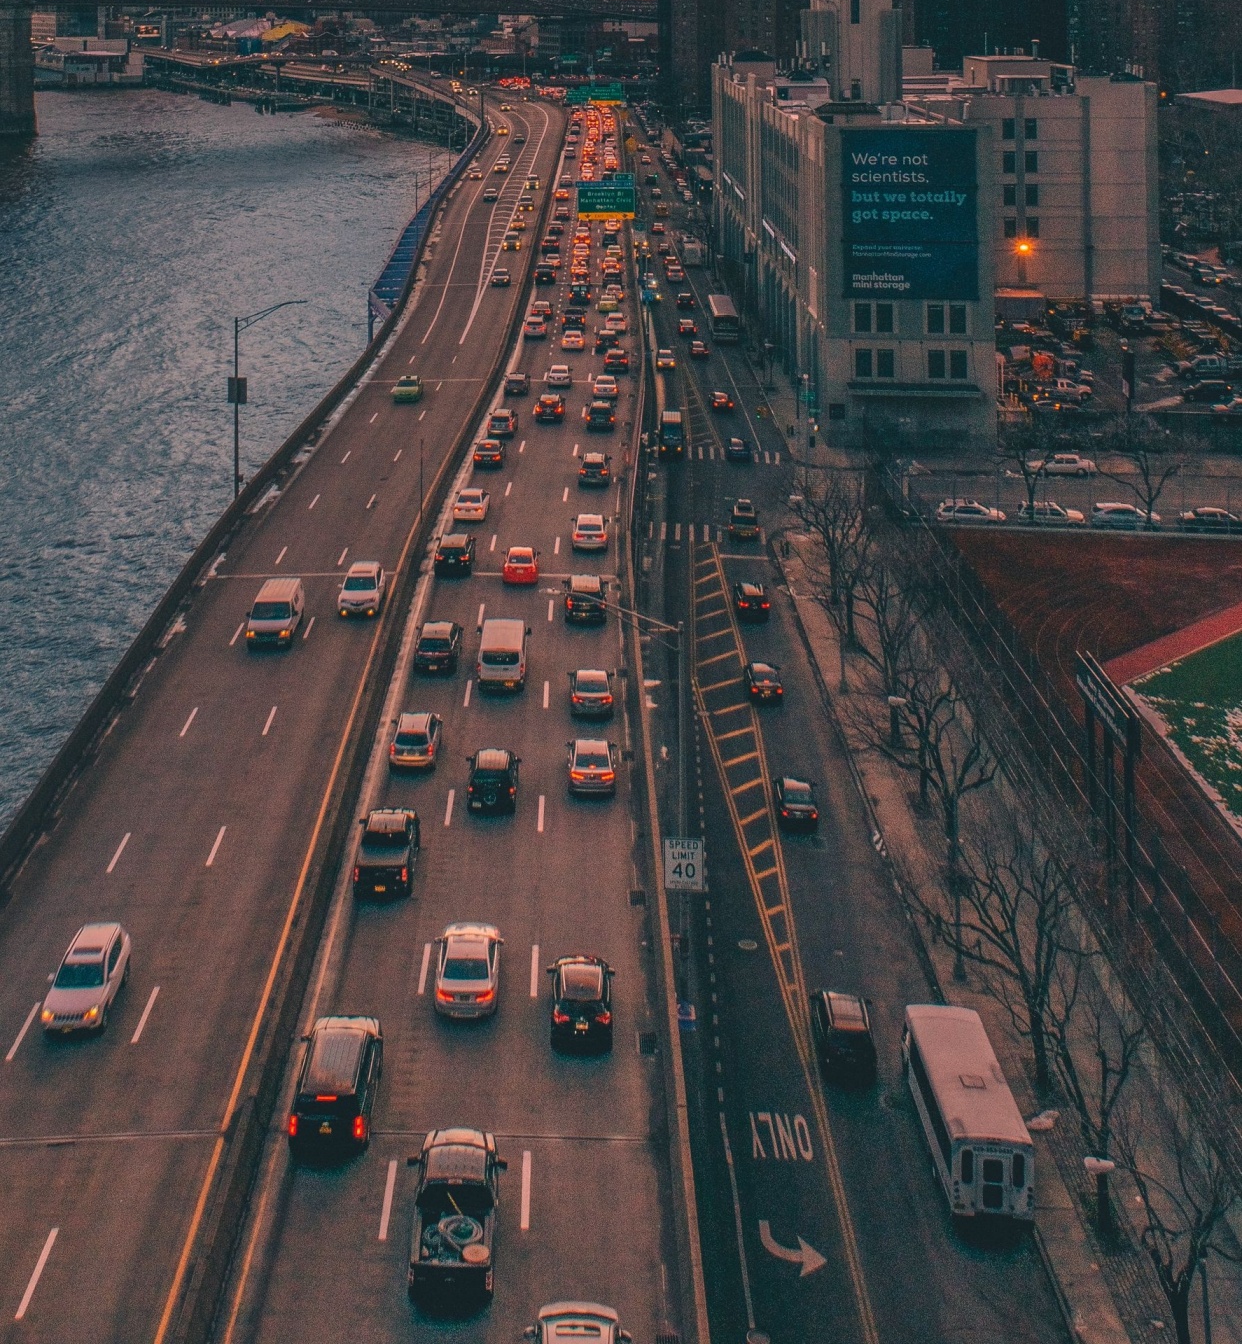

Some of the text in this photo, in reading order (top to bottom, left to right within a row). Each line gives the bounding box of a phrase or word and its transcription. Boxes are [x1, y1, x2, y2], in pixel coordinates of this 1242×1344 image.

[851, 152, 928, 166] We're not
[851, 190, 967, 206] but we totally
[852, 209, 933, 224] got space.
[852, 271, 904, 281] manhattan
[873, 282, 911, 291] storage
[669, 840, 699, 850] SPEED
[672, 851, 695, 860] LIMIT
[672, 862, 696, 878] 40
[749, 1111, 813, 1161] ONLY
